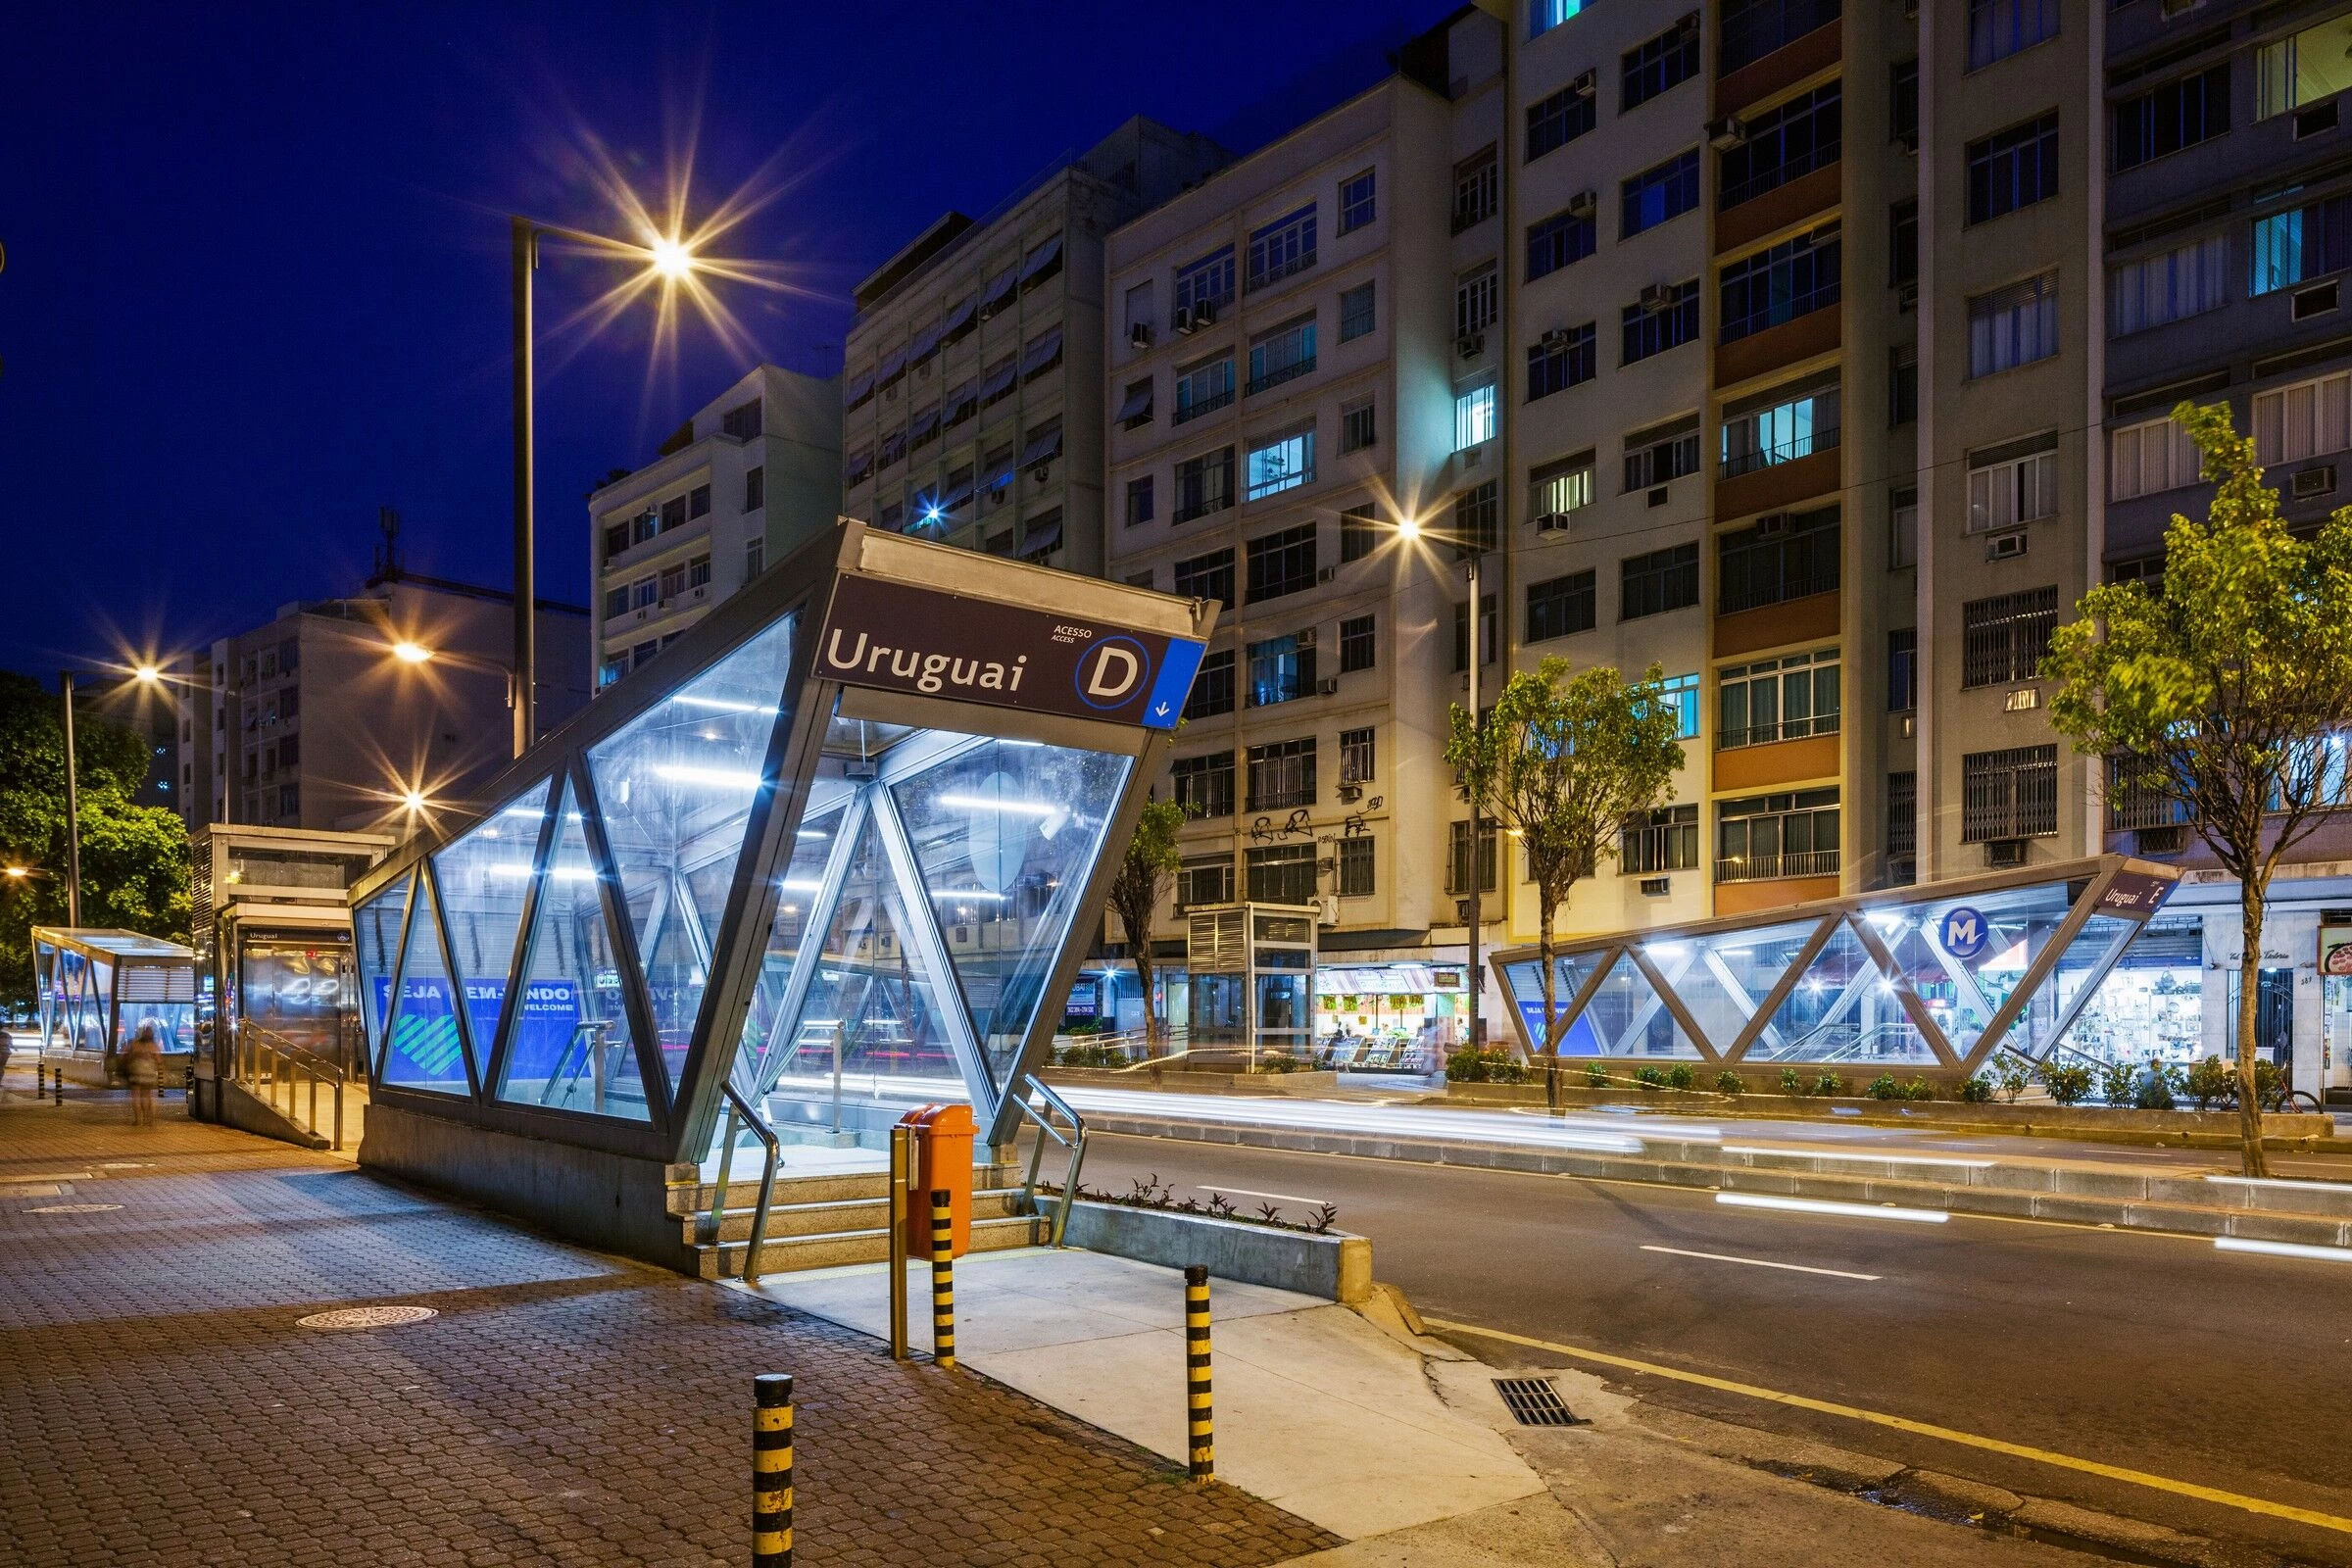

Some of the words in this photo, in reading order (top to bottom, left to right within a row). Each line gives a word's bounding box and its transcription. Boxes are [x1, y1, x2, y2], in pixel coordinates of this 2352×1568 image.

[1051, 635, 1075, 644] ACCESS
[1054, 624, 1092, 639] ACESSO
[828, 628, 1027, 693] Uruguai
[1088, 646, 1138, 697] D
[2105, 888, 2142, 907] Uruguai
[2148, 886, 2165, 904] E
